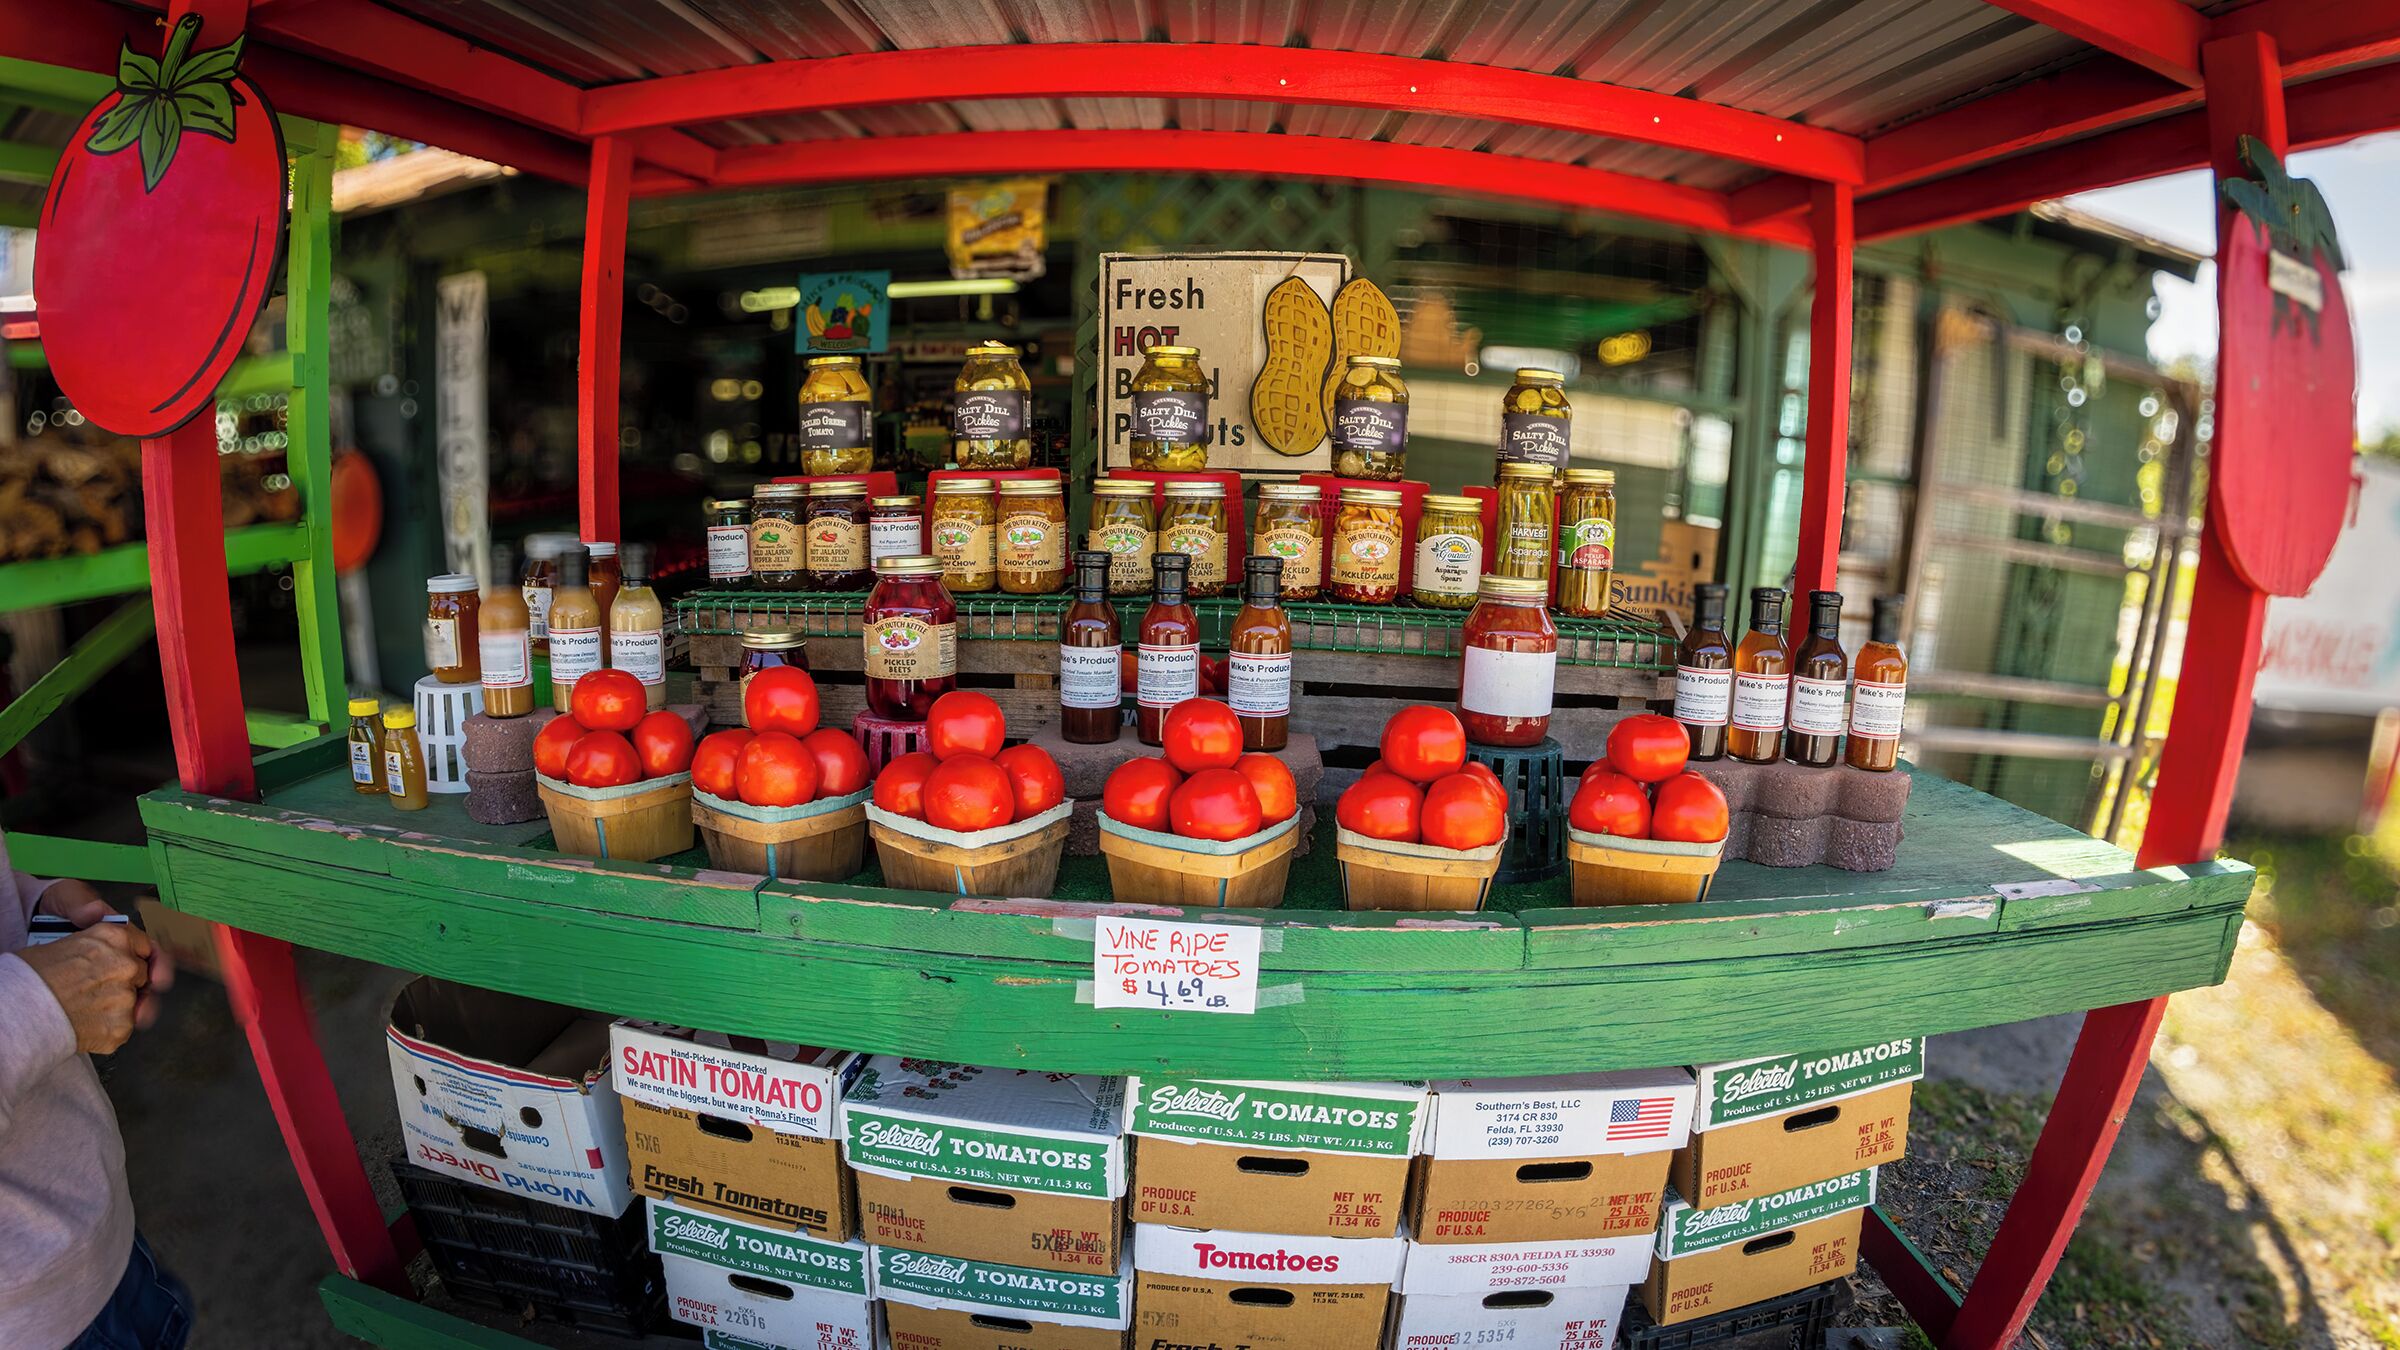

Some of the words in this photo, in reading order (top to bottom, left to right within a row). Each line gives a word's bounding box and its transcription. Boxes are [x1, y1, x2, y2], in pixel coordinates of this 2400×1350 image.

[1116, 277, 1204, 310] Fresh
[1115, 326, 1180, 356] HOT
[958, 406, 982, 417] SALTY
[985, 403, 1010, 416] DILL
[1140, 406, 1170, 418] SALTY
[1174, 406, 1197, 419] DILL
[962, 413, 1000, 430] Pickles
[1147, 416, 1188, 431] Pickles
[1339, 416, 1366, 425] SALTY
[1370, 415, 1393, 429] DILL
[808, 428, 833, 437] TOMATO
[1344, 424, 1384, 439] Pickles
[1513, 431, 1544, 440] SALTY
[1548, 432, 1566, 446] DILL
[1520, 440, 1559, 455] Pickles
[890, 524, 919, 532] Produce
[1032, 520, 1050, 531] KETTLE
[1513, 528, 1547, 537] HARVEST
[1348, 534, 1357, 542] THE
[1379, 534, 1394, 545] KETTLE
[1507, 546, 1549, 558] Asparagus
[1341, 571, 1370, 579] PICKLED
[1372, 571, 1394, 579] GARLIC
[1435, 567, 1468, 575] Asparagus
[875, 625, 885, 633] THE
[887, 622, 905, 630] DUTCH
[907, 622, 927, 634] KETTLE
[568, 637, 598, 645] Produce
[625, 638, 657, 646] Produce
[1079, 656, 1116, 665] Produce
[1158, 654, 1194, 662] Produce
[1230, 661, 1254, 673] Mike's
[1258, 664, 1290, 673] Produce
[1739, 680, 1762, 689] Mike's
[1798, 685, 1823, 696] Mike's
[1859, 688, 1883, 698] Mike's
[1107, 926, 1159, 951] VINE
[1170, 931, 1229, 957] RIPE
[1102, 954, 1240, 979] TOMATOES
[1147, 978, 1203, 1006] 4.69
[1206, 995, 1229, 1007] LB.
[670, 1049, 715, 1065] Hand-Picked
[721, 1059, 740, 1070] Hand
[743, 1063, 767, 1074] Packed
[1722, 1059, 1798, 1104] Selected
[1803, 1038, 1912, 1079] TOMATOES
[623, 1046, 697, 1089] SATIN
[704, 1064, 823, 1113] TOMATO
[627, 1077, 638, 1087] We
[639, 1081, 651, 1091] are
[653, 1084, 665, 1095] not
[666, 1086, 679, 1097] the
[679, 1091, 711, 1106] biggest,
[712, 1096, 725, 1108] but
[727, 1101, 738, 1110] we
[740, 1104, 753, 1114] are
[755, 1106, 787, 1121] Ronna's
[789, 1112, 817, 1126] Finest!
[1149, 1085, 1245, 1121] Selected
[1252, 1101, 1399, 1130] TOMATOES
[1475, 1101, 1531, 1112] Southern's
[1534, 1100, 1558, 1111] Best,
[1561, 1100, 1581, 1108] LLC
[1496, 1113, 1520, 1122] 3174
[1523, 1113, 1539, 1121] CR
[1540, 1112, 1557, 1121] 830
[1149, 1120, 1196, 1133] Produce
[1199, 1124, 1212, 1135] of
[1214, 1127, 1247, 1138] U.S.A.
[1252, 1131, 1265, 1139] 25
[1269, 1133, 1293, 1142] LBS.
[1298, 1135, 1321, 1144] NET
[1323, 1136, 1342, 1146] WT.
[1345, 1138, 1373, 1148] /11.3
[1377, 1140, 1393, 1150] KG
[1486, 1126, 1518, 1135] Felda,
[1520, 1125, 1532, 1133] FL
[1535, 1124, 1563, 1133] 33930
[503, 1130, 549, 1147] Contents:
[859, 1120, 943, 1157] Selected
[950, 1138, 1092, 1171] TOMATOES
[1488, 1136, 1513, 1147] (239)
[1516, 1135, 1559, 1145] 707-3260
[421, 1144, 500, 1182] Direct
[1706, 1162, 1752, 1183] PRODUCE
[503, 1172, 595, 1207] World
[644, 1164, 704, 1196] Fresh
[713, 1182, 828, 1225] Tomatoes
[1142, 1186, 1196, 1202] PRODUCE
[1142, 1202, 1156, 1213] OF
[1159, 1203, 1194, 1215] U.S.A.
[1683, 1198, 1754, 1236] Selected
[1759, 1171, 1861, 1213] TOMATOES
[1438, 1211, 1490, 1222] PRODUCE
[1436, 1226, 1450, 1235] OF
[1453, 1225, 1486, 1235] U.S.A.
[663, 1216, 730, 1250] Selected
[736, 1235, 851, 1272] TOMATOES
[1193, 1243, 1339, 1272] Tomatoes
[1448, 1254, 1486, 1264] 388CR
[1490, 1252, 1519, 1262] 830A
[1522, 1251, 1562, 1261] FELDA
[1564, 1250, 1579, 1258] FL
[1581, 1248, 1615, 1257] 33930
[890, 1254, 968, 1284] Selected
[975, 1269, 1105, 1297] TOMATOES
[1491, 1263, 1568, 1274] 239-600-5336
[1489, 1276, 1566, 1286] 239-872-5604
[677, 1296, 718, 1314] PRODUCE
[679, 1308, 690, 1318] OF
[693, 1313, 719, 1326] U.S.A.
[726, 1310, 765, 1329] 22676
